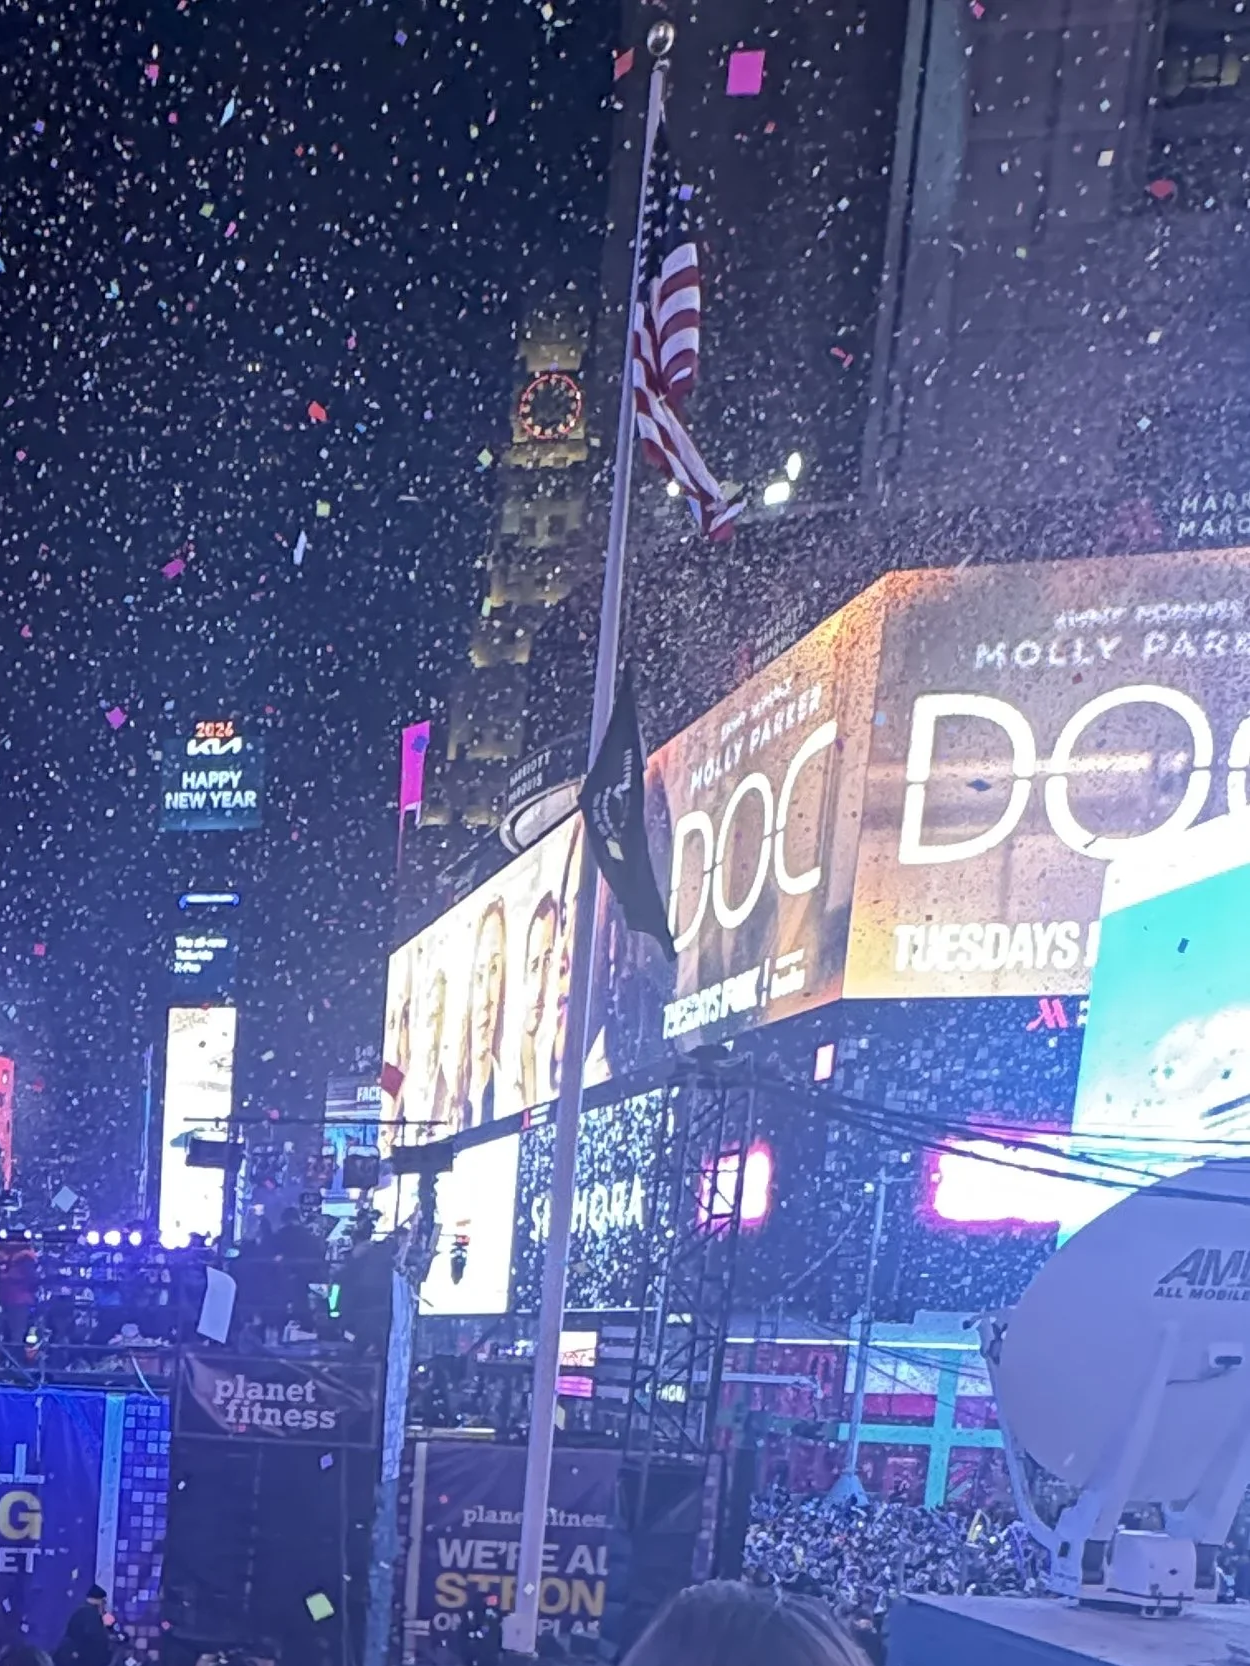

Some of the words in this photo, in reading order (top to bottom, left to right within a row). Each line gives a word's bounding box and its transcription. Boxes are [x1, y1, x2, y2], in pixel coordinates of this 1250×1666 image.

[973, 636, 1123, 668] MOLLY
[193, 721, 235, 738] 2026
[690, 731, 744, 801] MOLLY
[749, 682, 822, 756] PARKER
[181, 769, 243, 790] HAPPY
[164, 791, 207, 810] NEW
[209, 790, 258, 809] YEAR
[667, 719, 838, 953] DOC
[893, 920, 1081, 972] TUESDAYS
[1153, 1286, 1183, 1299] ALL
[212, 1374, 317, 1406] planet
[225, 1398, 337, 1430] fitness
